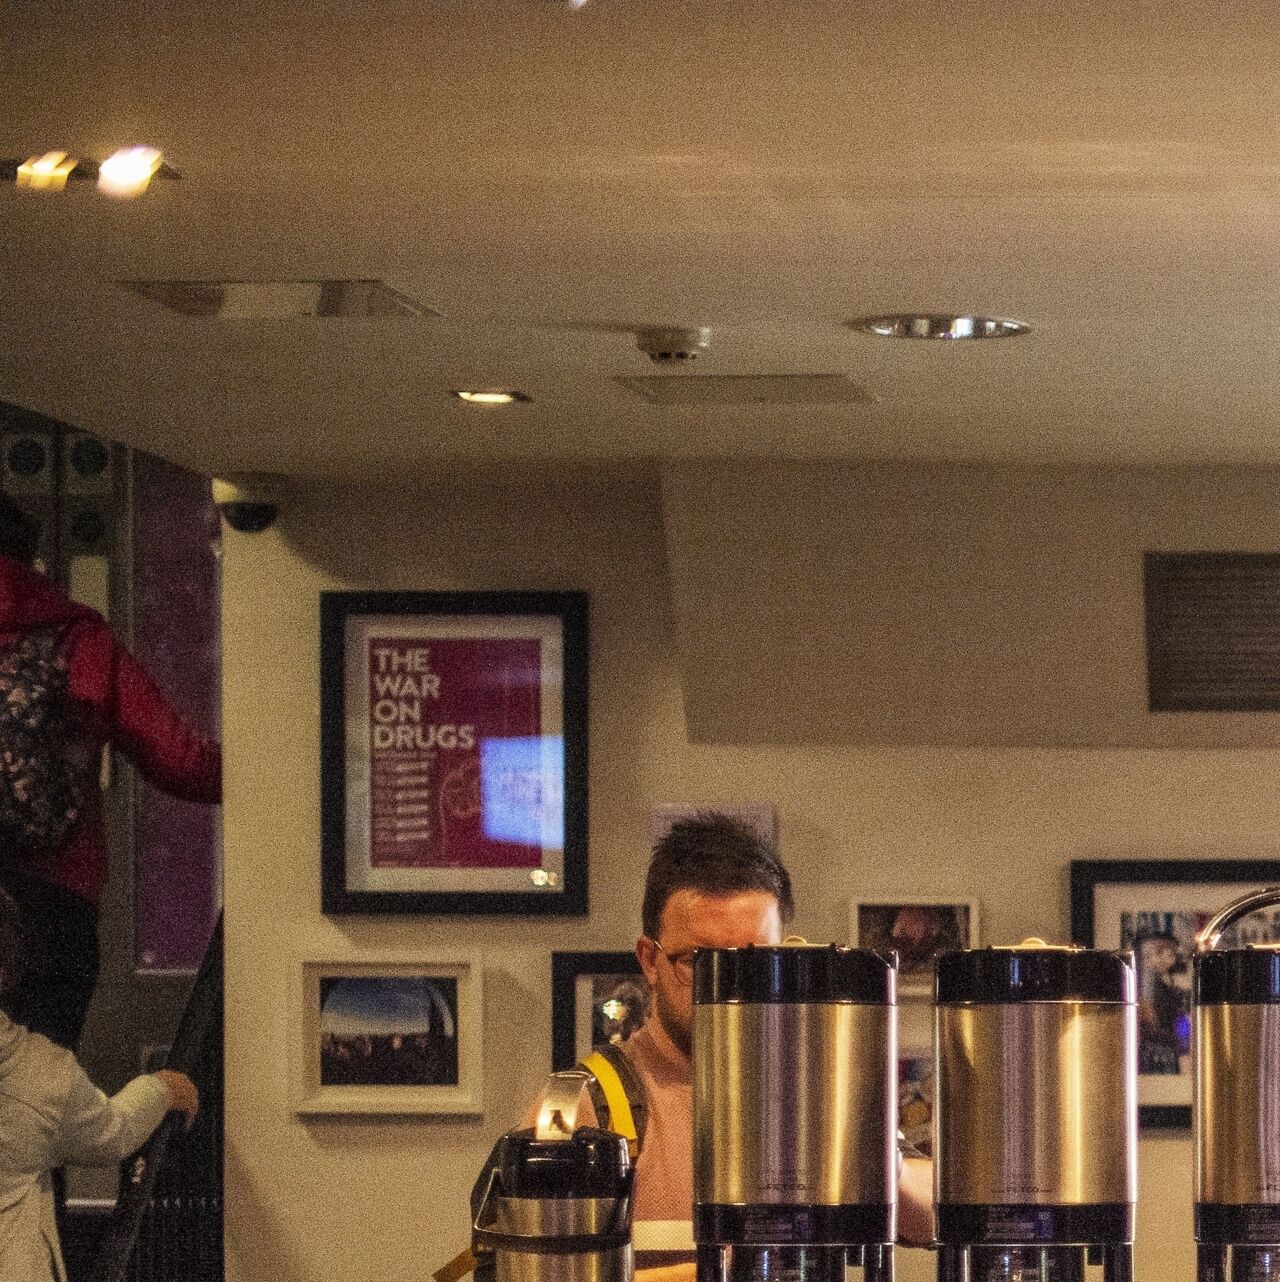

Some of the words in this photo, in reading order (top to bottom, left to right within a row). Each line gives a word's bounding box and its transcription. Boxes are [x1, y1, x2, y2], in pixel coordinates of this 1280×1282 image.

[373, 648, 430, 672] THE
[373, 673, 441, 700] WAR
[373, 699, 421, 724] ON
[373, 724, 475, 750] DRUGS
